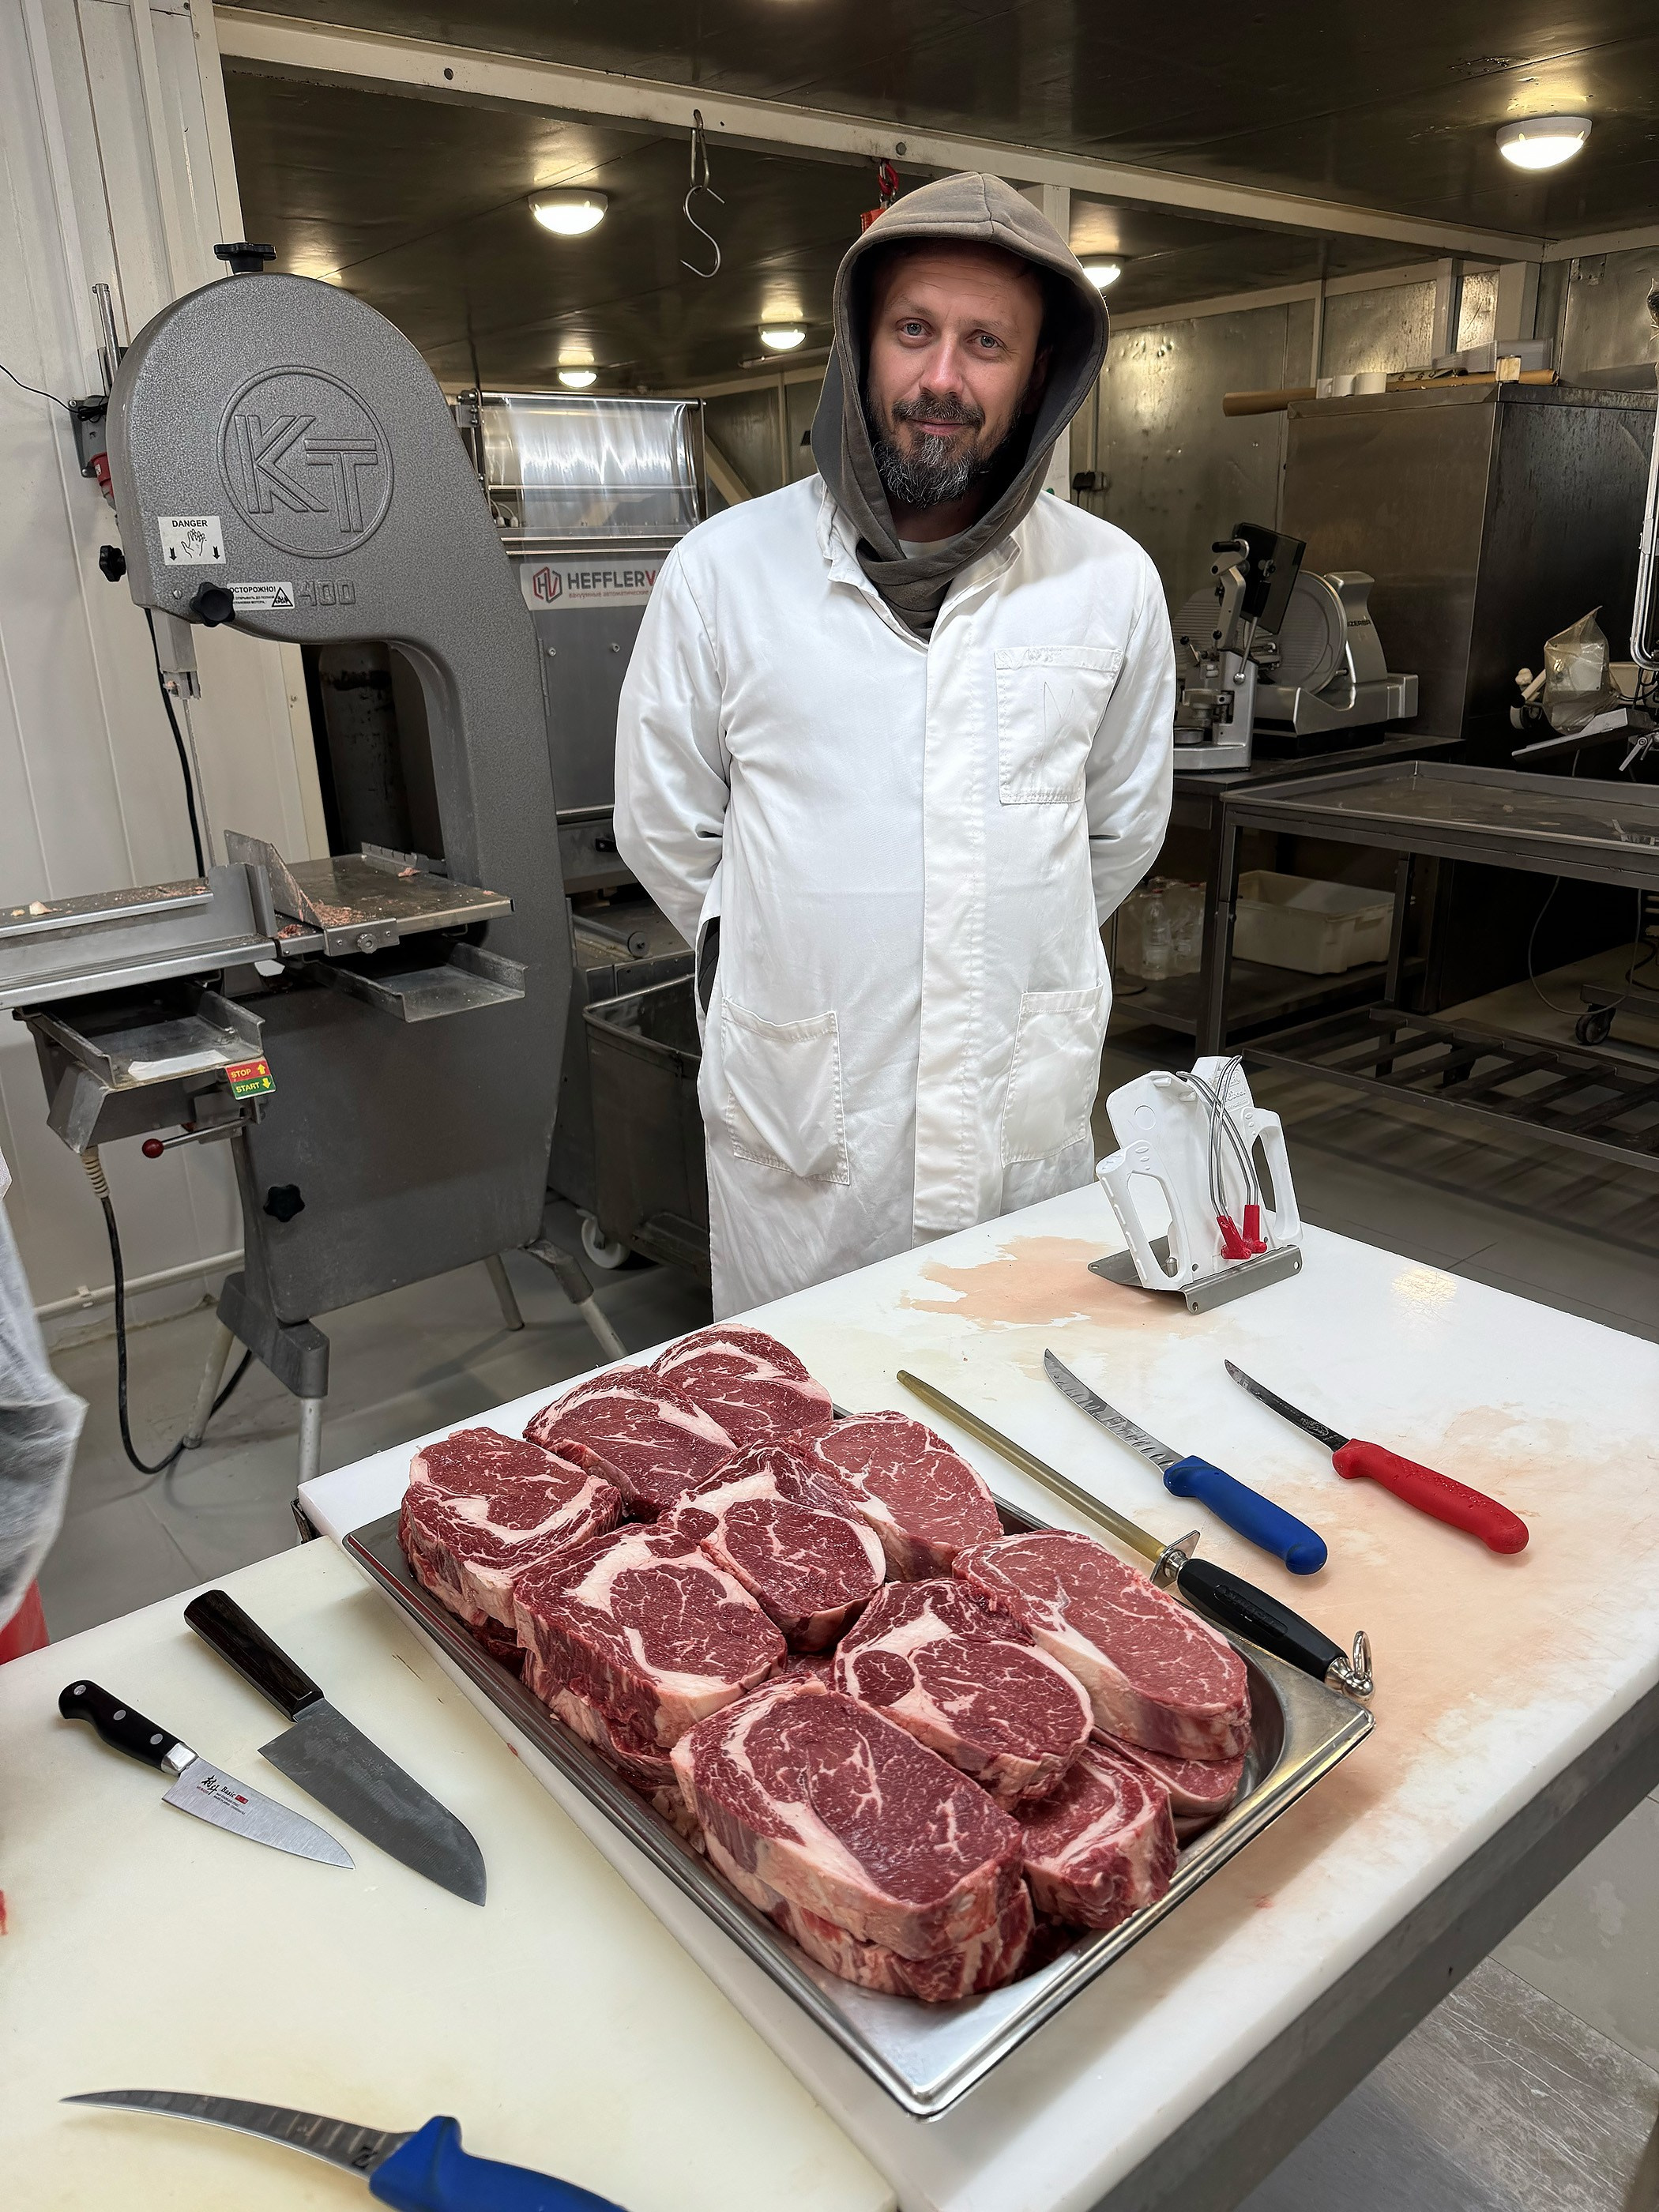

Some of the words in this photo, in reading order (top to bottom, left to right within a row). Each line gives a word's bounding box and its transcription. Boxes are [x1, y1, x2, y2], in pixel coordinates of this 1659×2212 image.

[234, 415, 378, 532] KT
[567, 570, 656, 590] HEFFLERV
[298, 581, 356, 606] 400
[231, 1068, 251, 1078] STOP
[235, 1082, 260, 1093] START
[221, 1786, 236, 1798] Basic
